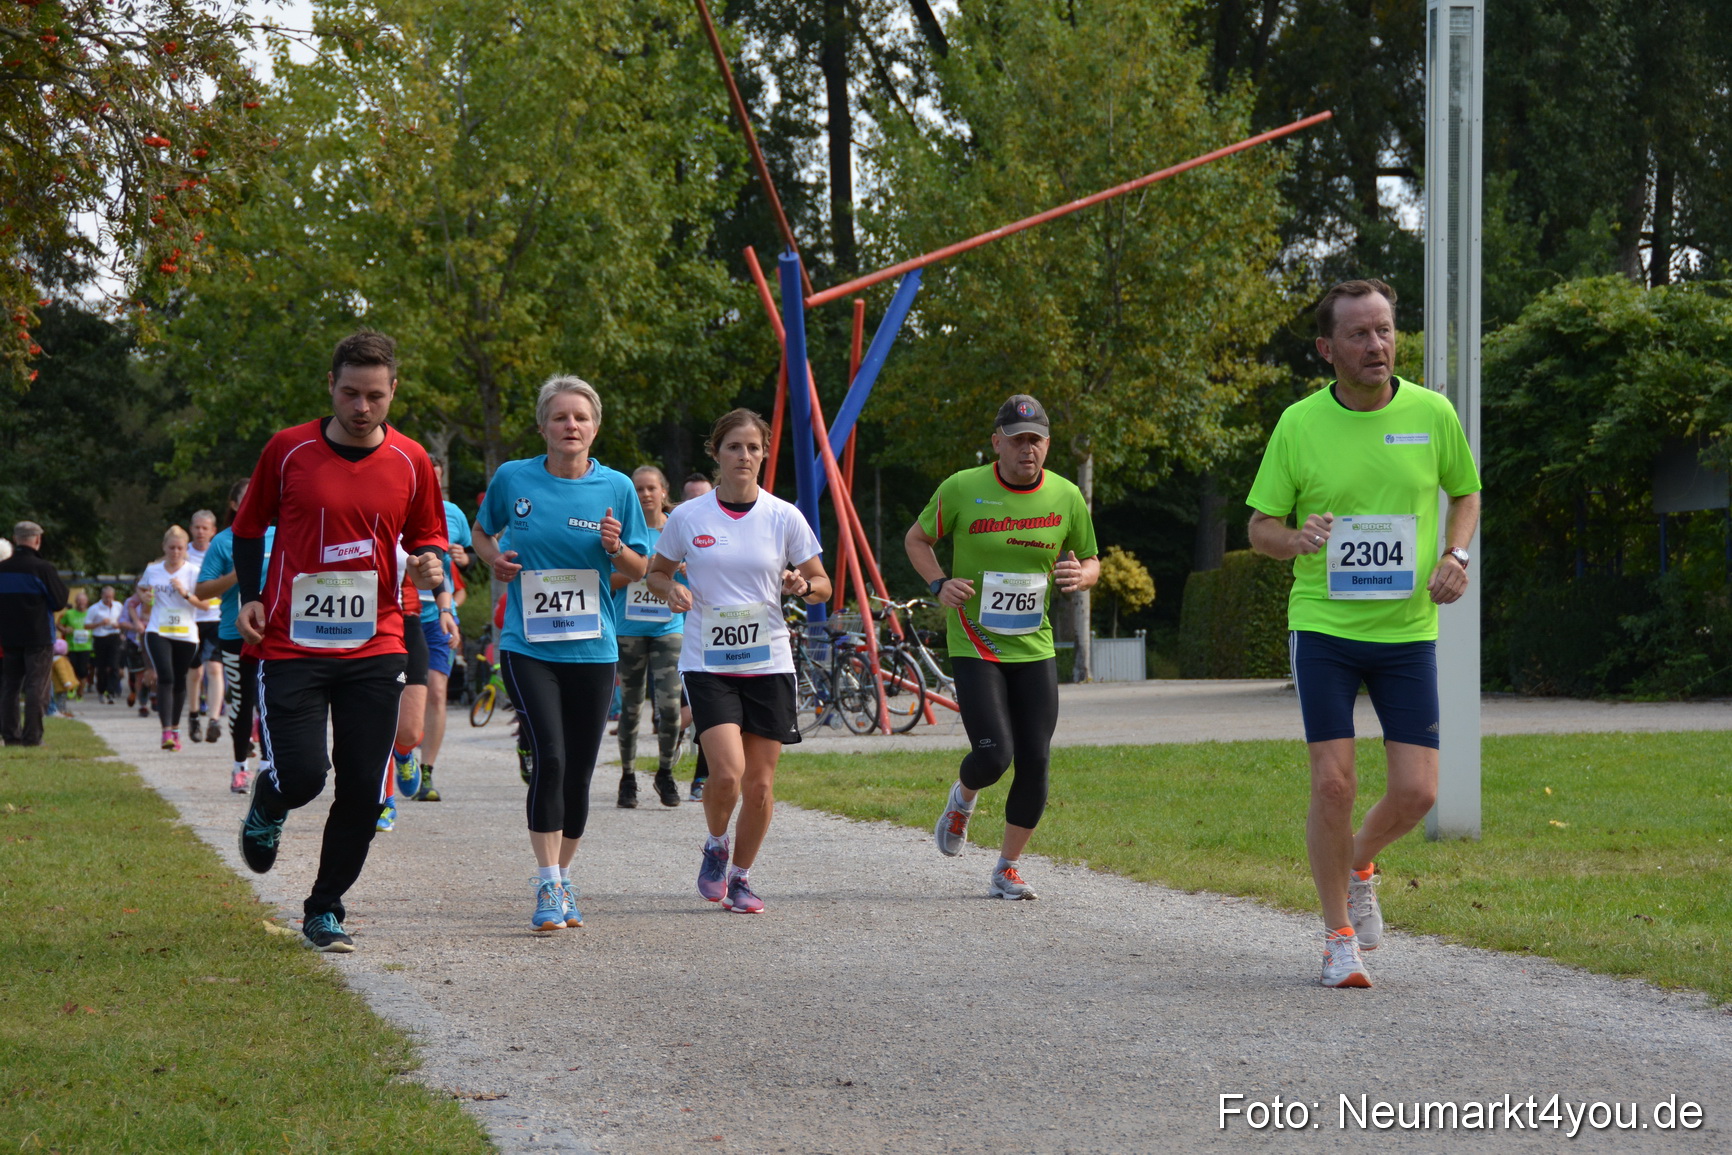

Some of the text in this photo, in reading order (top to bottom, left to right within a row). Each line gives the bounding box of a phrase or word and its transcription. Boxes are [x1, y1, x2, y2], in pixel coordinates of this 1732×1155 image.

[338, 546, 360, 556] DEHN
[1340, 541, 1403, 567] 2304
[1352, 576, 1393, 585] Bernhard
[304, 594, 365, 618] 2410
[534, 589, 586, 613] 2471
[991, 591, 1036, 611] 2765
[315, 625, 352, 634] Matthias
[552, 620, 575, 628] Ulrike
[711, 622, 759, 647] 2607
[726, 651, 751, 661] Kerstin
